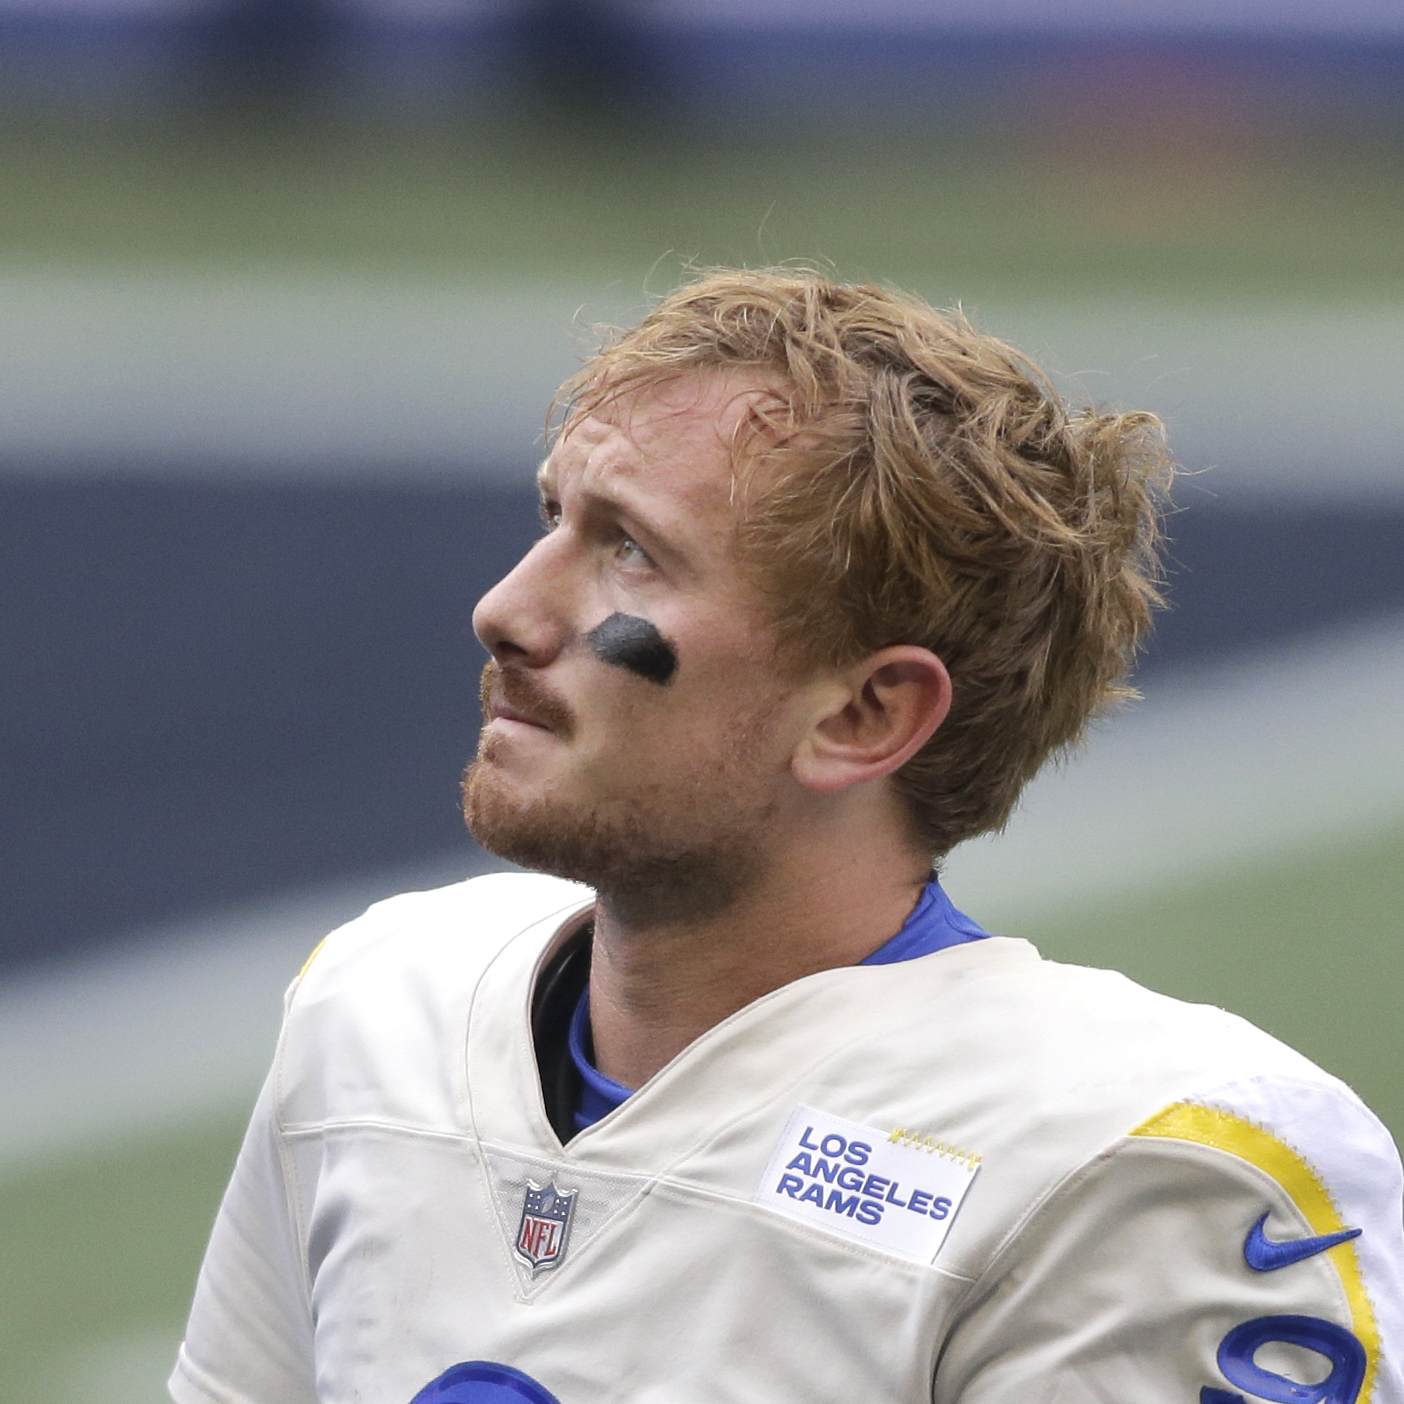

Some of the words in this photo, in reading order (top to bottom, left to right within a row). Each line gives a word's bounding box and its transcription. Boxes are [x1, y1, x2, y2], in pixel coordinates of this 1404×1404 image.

[798, 1125, 873, 1166] LOS
[775, 1173, 886, 1226] RAMS
[785, 1151, 953, 1221] ANGELES
[519, 1217, 558, 1260] NFL
